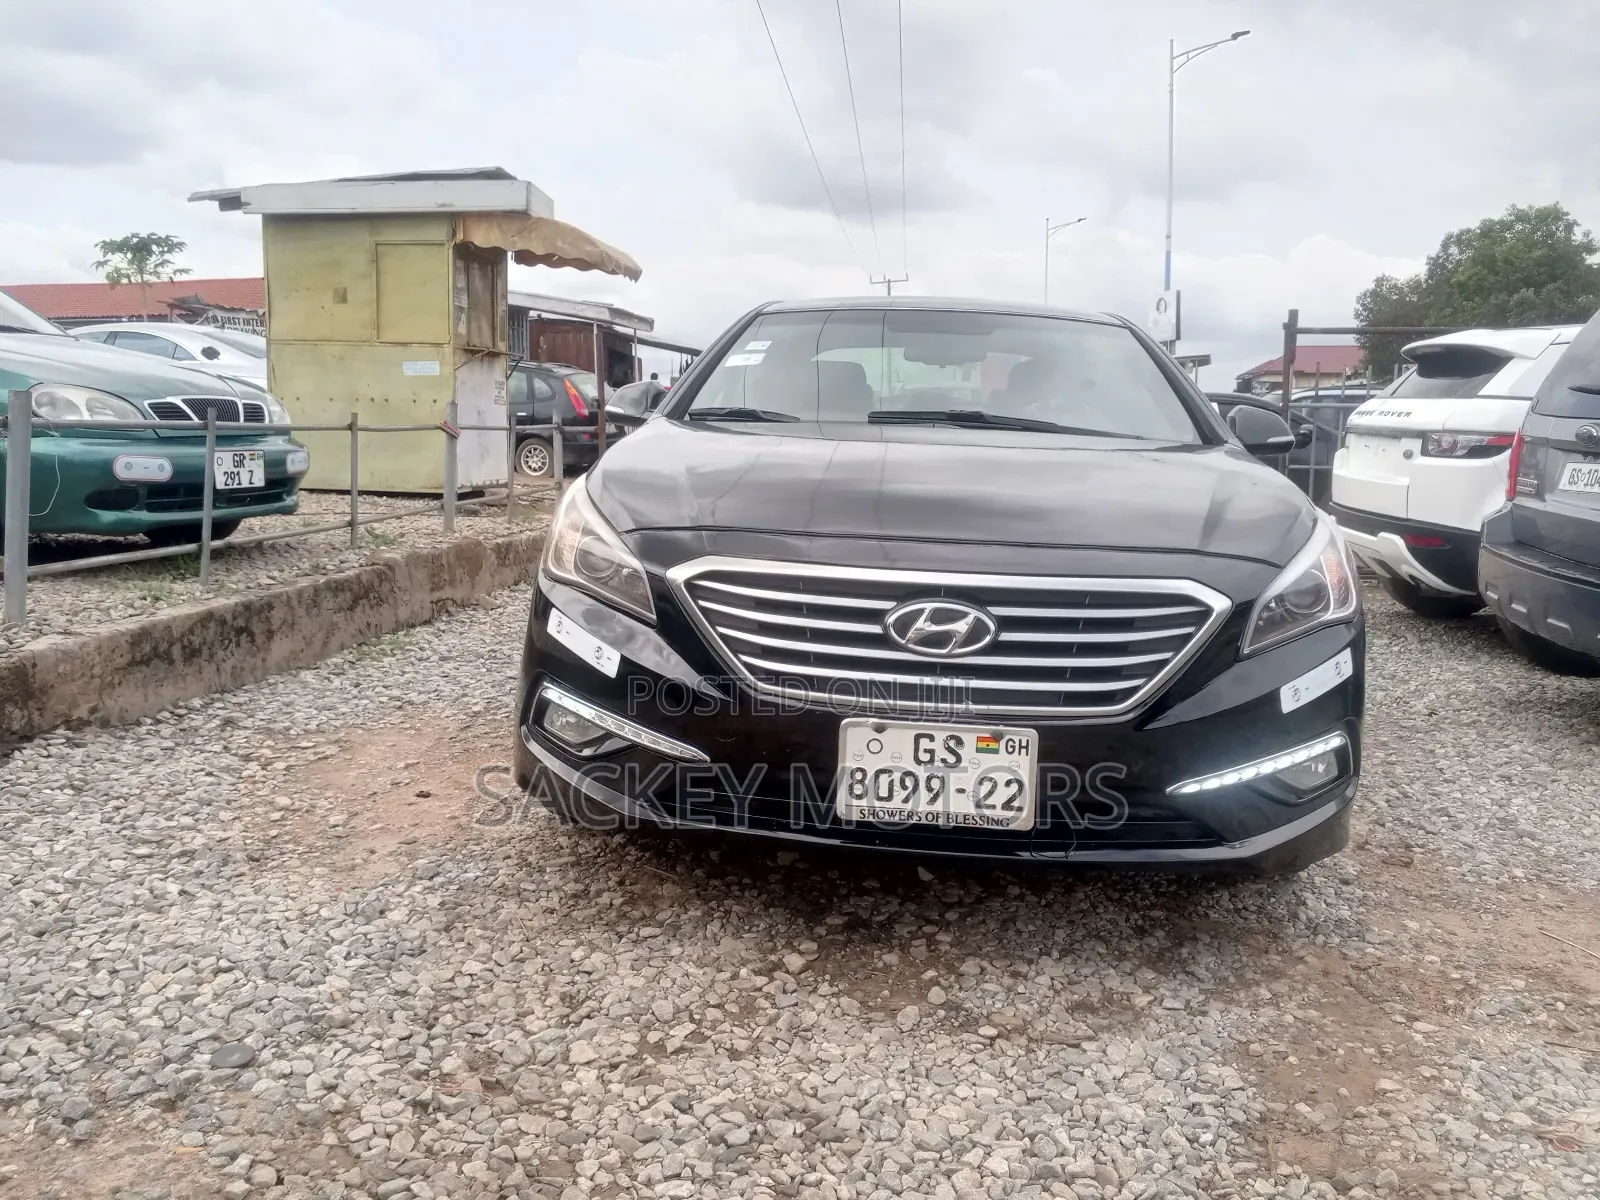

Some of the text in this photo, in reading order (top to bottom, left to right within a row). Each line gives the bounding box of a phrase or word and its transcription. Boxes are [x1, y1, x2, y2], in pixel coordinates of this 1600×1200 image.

[220, 316, 241, 326] FIRST
[232, 453, 246, 468] GR
[223, 470, 255, 486] 291 Z
[1568, 468, 1582, 486] GS
[913, 732, 1030, 769] GS GH
[859, 808, 1010, 828] SHOWERS OF BLESSING
